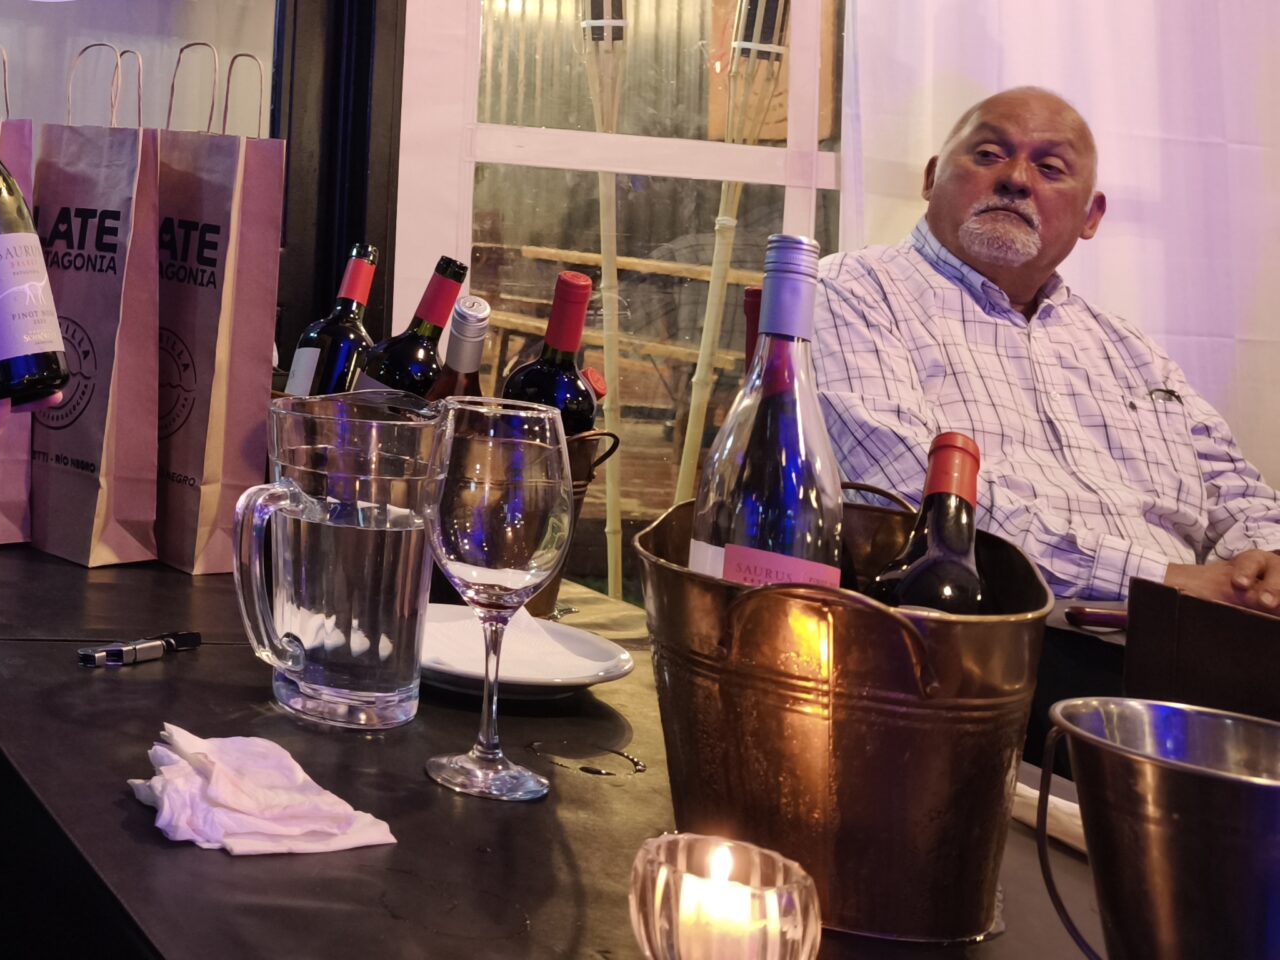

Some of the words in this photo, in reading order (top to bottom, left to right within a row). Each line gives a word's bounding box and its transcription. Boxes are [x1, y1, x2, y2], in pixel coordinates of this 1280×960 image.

[160, 216, 221, 268] ATE
[45, 250, 117, 276] TAGONIA
[735, 562, 793, 583] SAURUS
